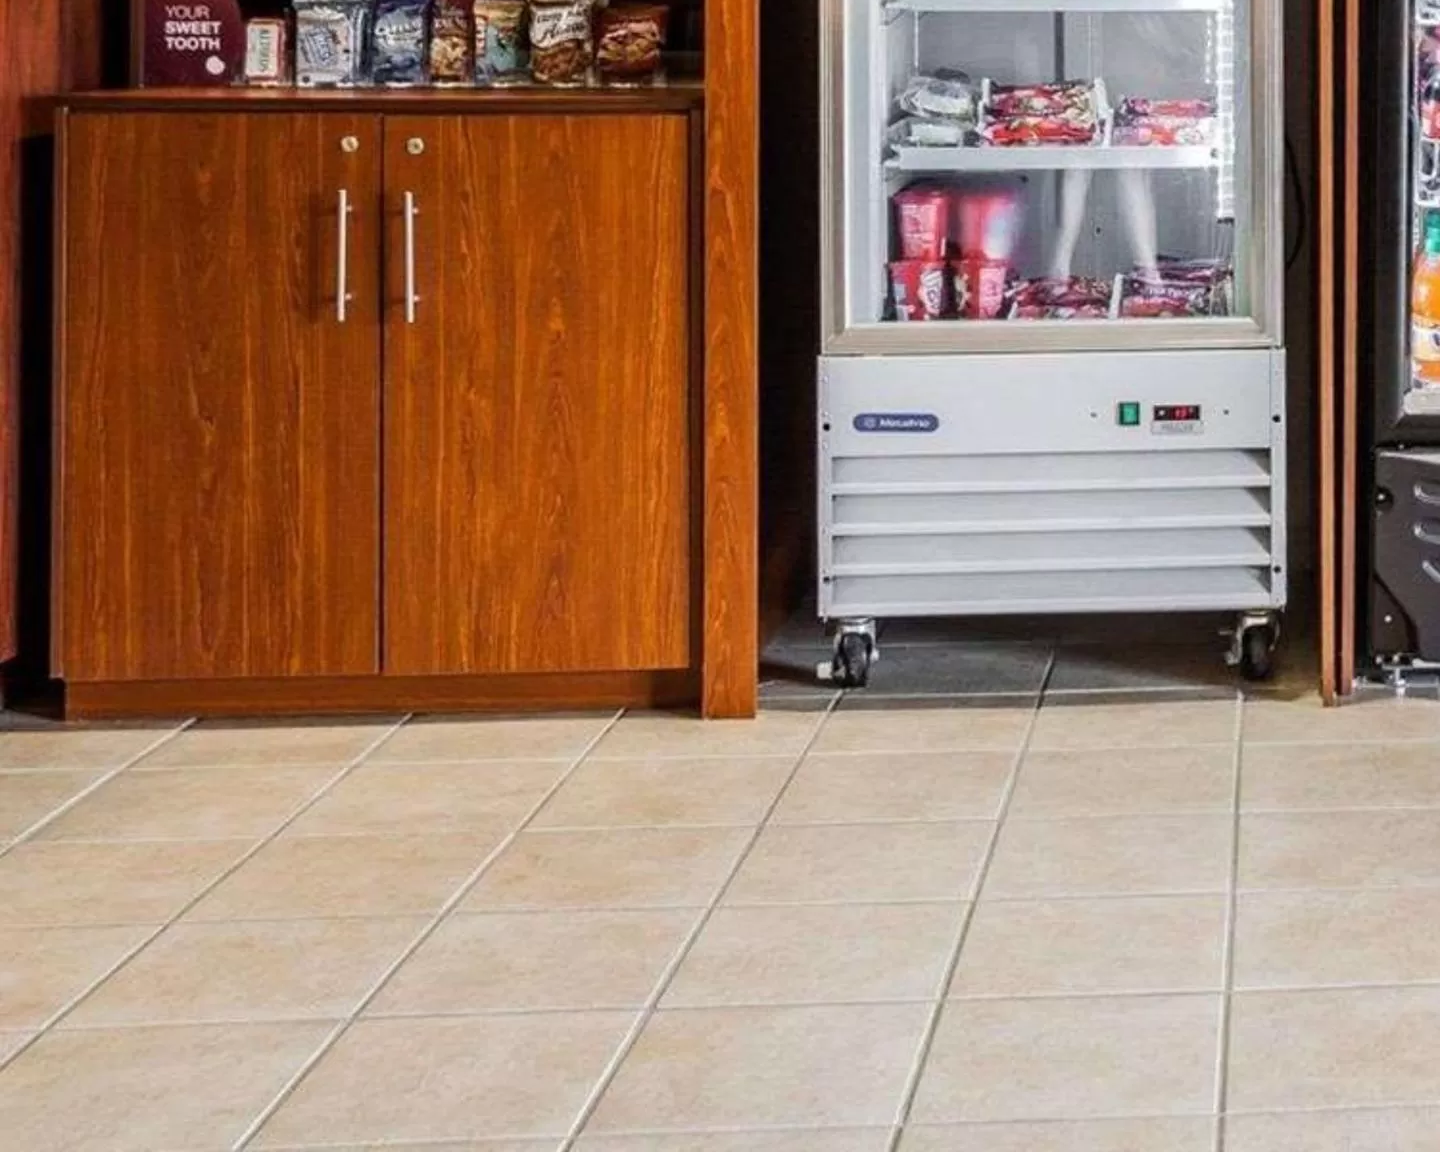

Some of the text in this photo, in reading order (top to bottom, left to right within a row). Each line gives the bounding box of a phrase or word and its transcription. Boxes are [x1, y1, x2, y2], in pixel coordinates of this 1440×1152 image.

[164, 5, 210, 19] YOUR
[164, 21, 222, 36] SWEET
[165, 36, 222, 51] TOOTH
